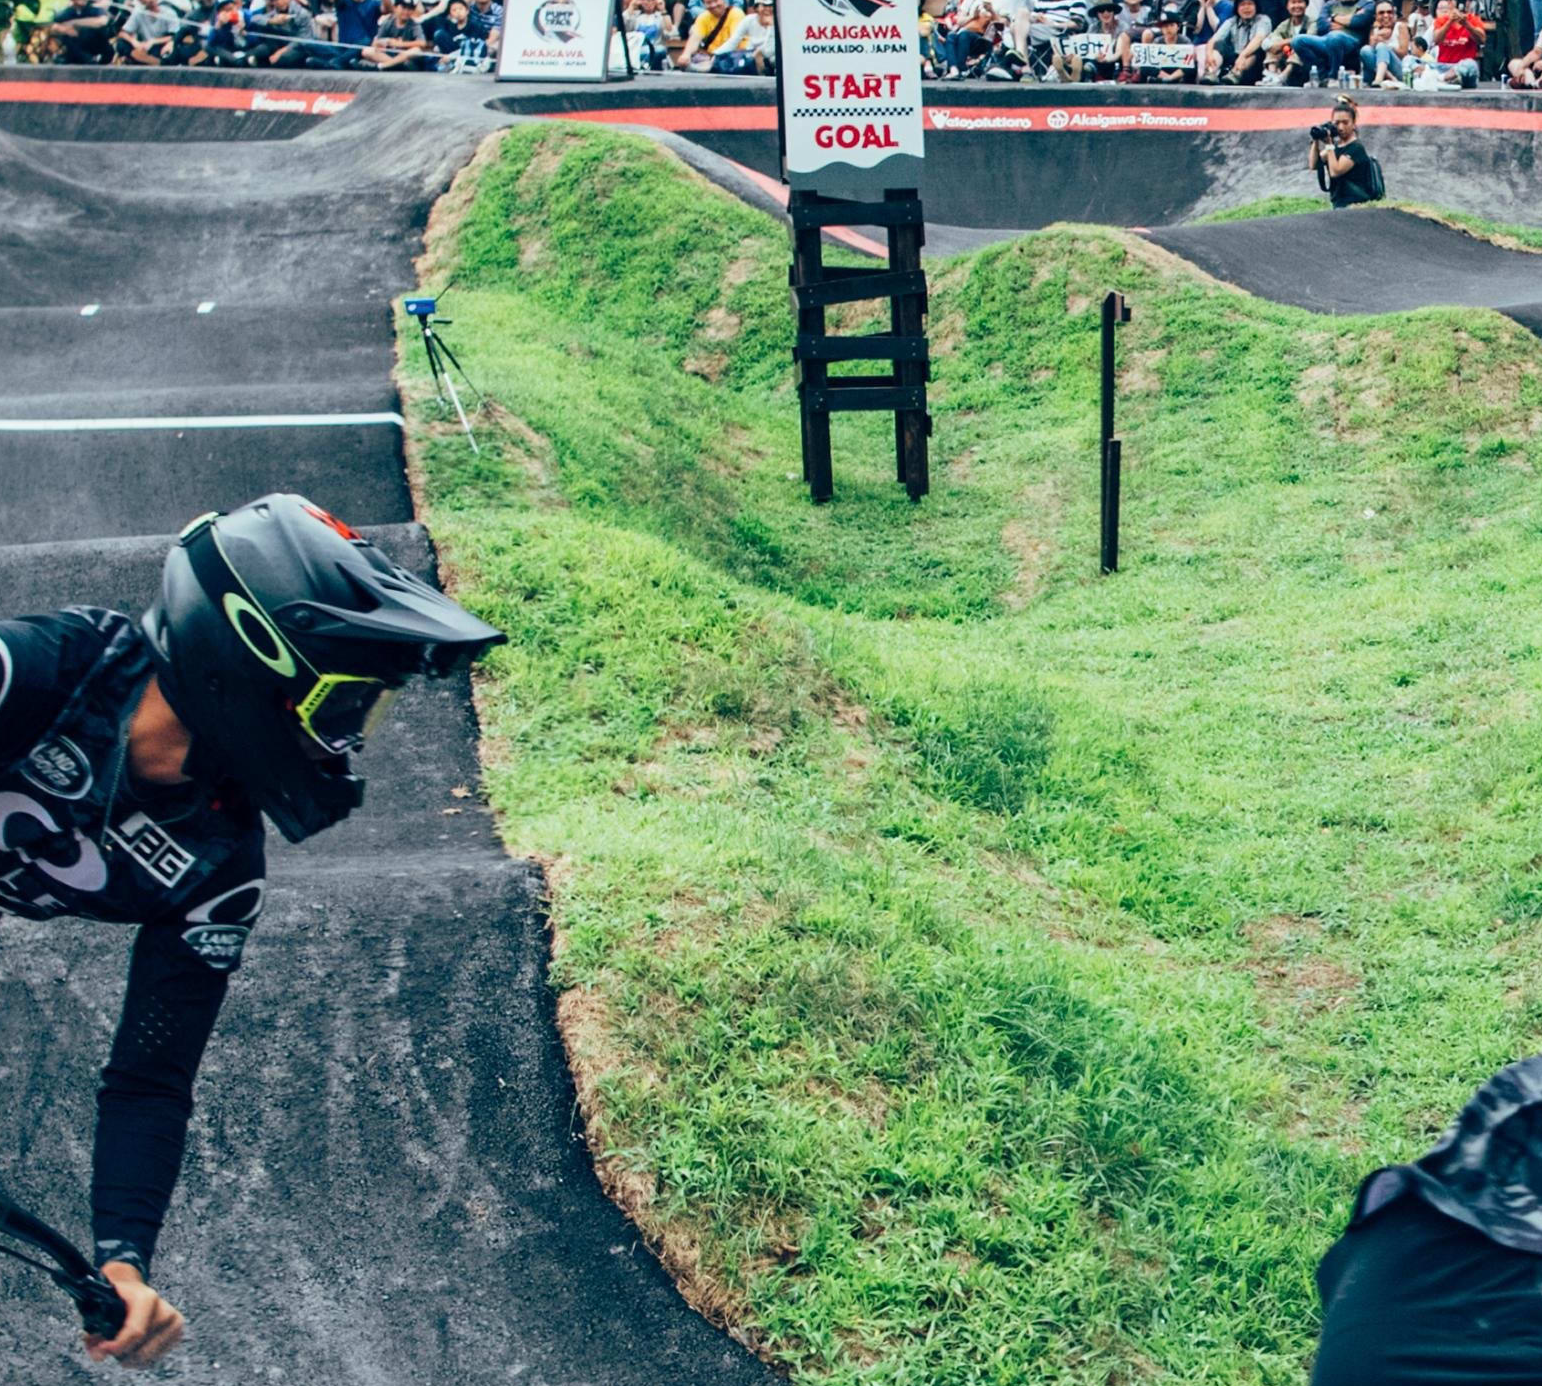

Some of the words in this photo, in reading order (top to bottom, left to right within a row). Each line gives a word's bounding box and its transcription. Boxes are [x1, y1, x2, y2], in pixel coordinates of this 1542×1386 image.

[805, 24, 902, 40] AKAIGAWA
[521, 48, 585, 59] AKAIGAWA
[871, 44, 908, 55] JAPAN
[803, 74, 901, 100] START
[1069, 111, 1208, 127] Akaigawa-Tomo.com
[815, 123, 899, 149] GOAL
